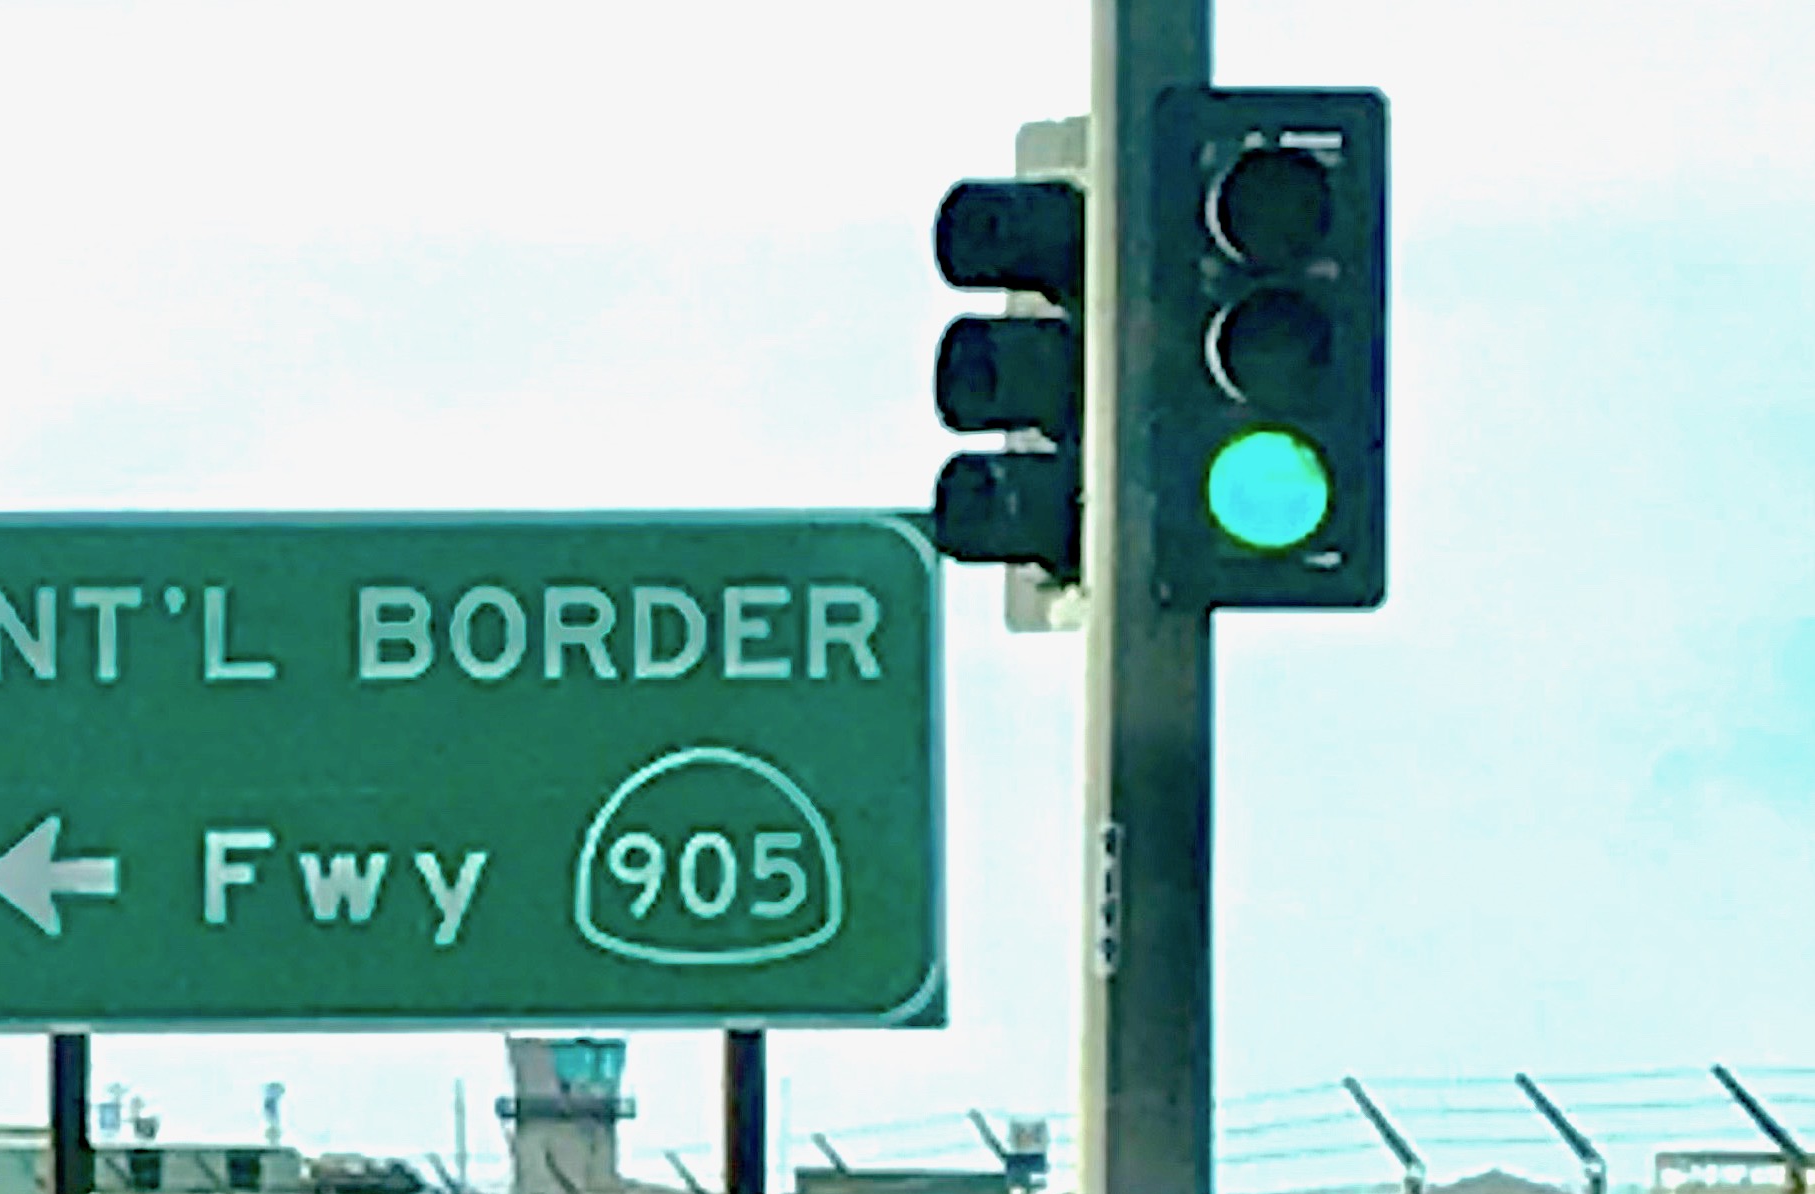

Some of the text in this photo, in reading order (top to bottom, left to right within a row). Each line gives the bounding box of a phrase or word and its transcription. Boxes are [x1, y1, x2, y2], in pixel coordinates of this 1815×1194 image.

[357, 585, 884, 683] BORDER
[203, 828, 809, 945] Fwy 905
